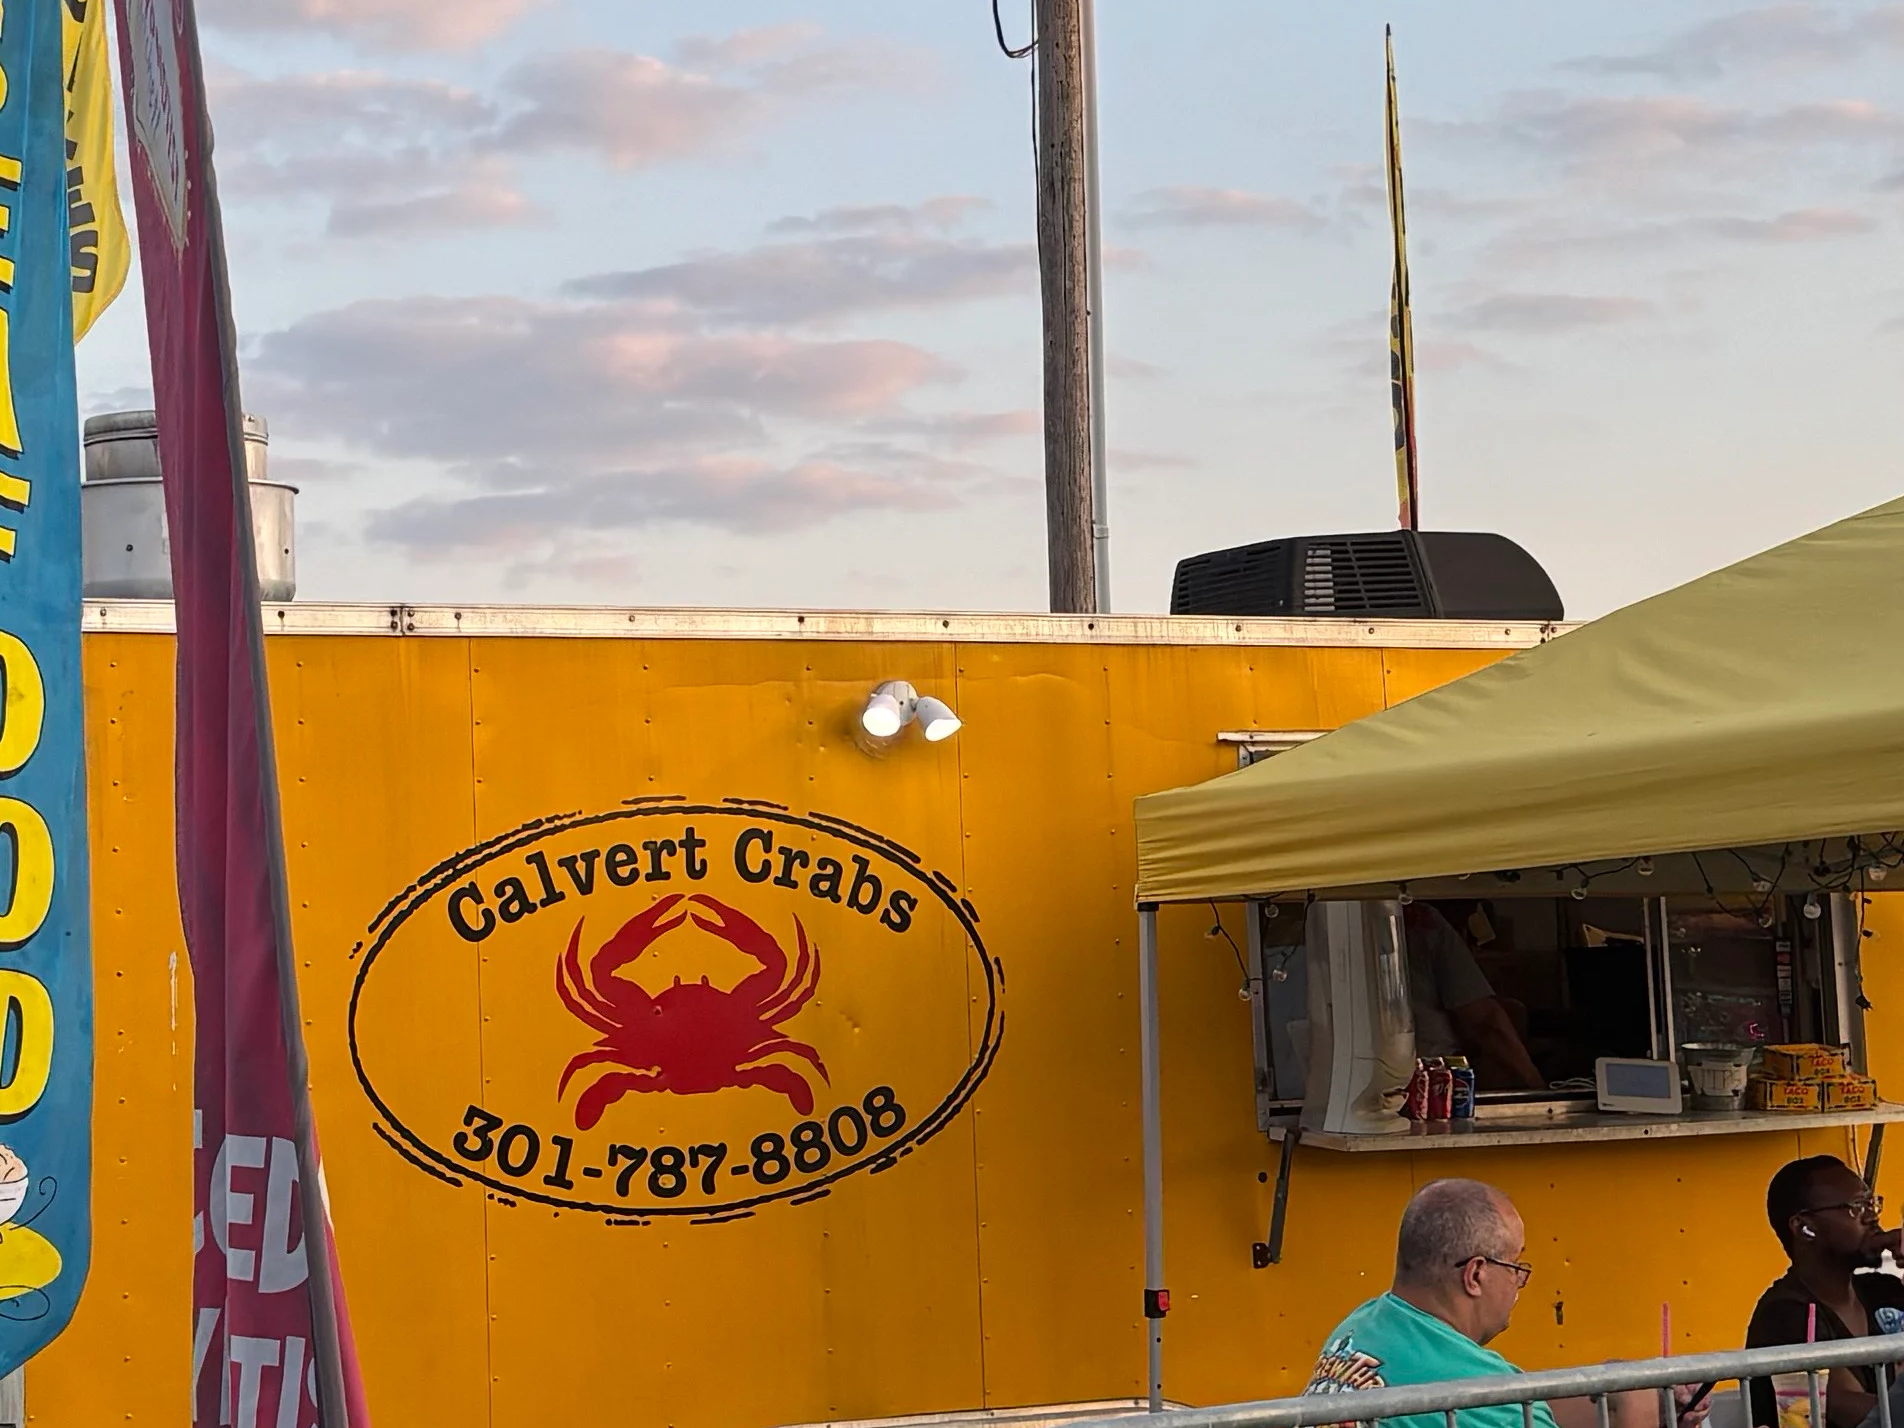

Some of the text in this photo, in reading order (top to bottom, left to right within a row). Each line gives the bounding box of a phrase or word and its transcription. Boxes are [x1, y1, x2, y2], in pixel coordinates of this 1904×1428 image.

[446, 825, 921, 945] Calvert Crabs
[451, 1084, 909, 1199] 301-787-8808
